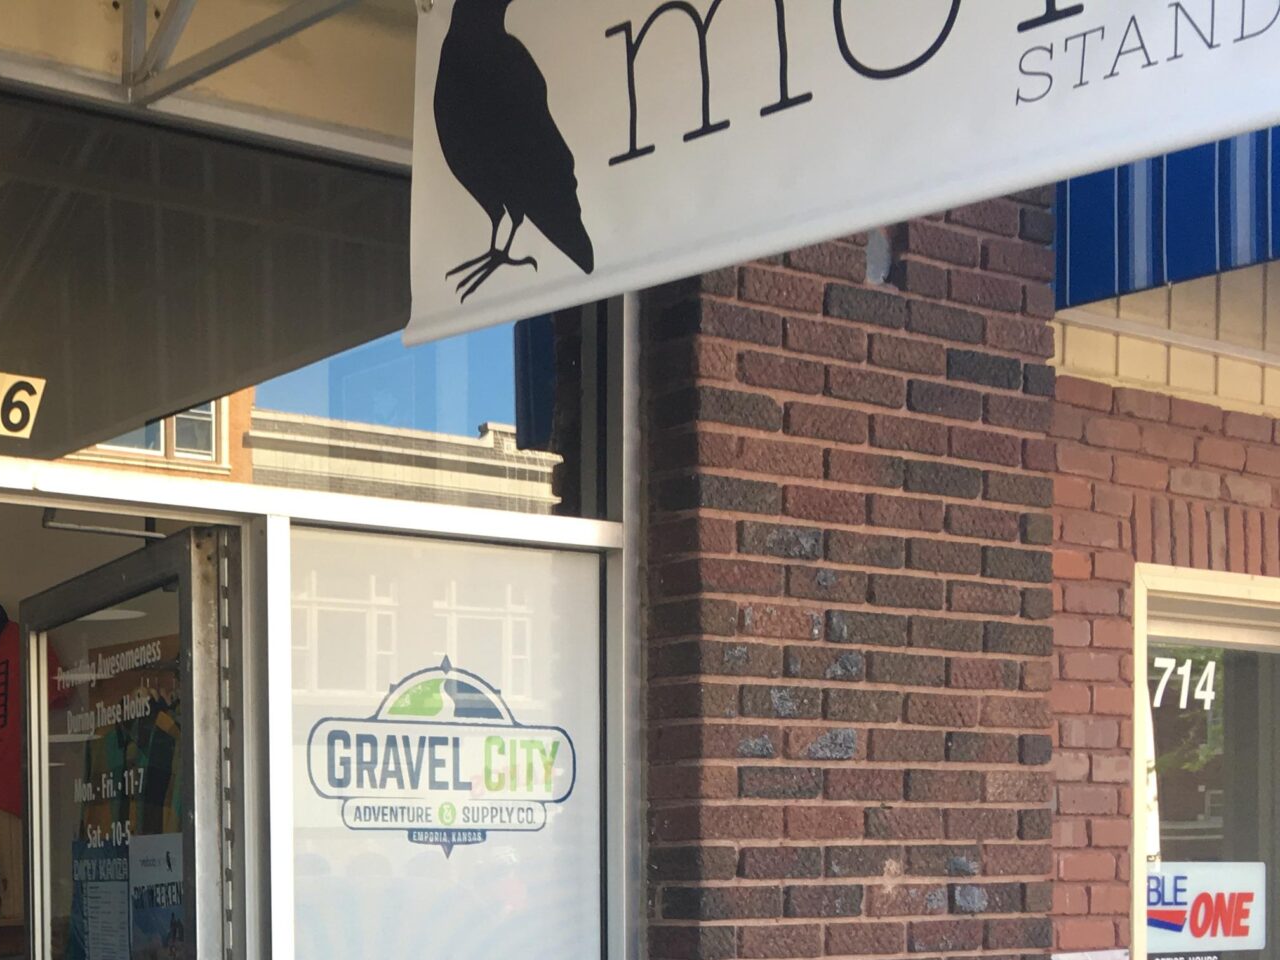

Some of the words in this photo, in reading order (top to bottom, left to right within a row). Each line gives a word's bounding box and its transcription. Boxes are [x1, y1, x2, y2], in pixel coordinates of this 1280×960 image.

[57, 661, 96, 691] Providing
[97, 640, 161, 680] Awesomeness
[1153, 657, 1216, 711] 714
[67, 708, 95, 735] During
[96, 702, 122, 728] These
[123, 694, 151, 721] Hours
[326, 730, 472, 791] GRAVEL
[483, 735, 561, 793] CITY
[74, 778, 96, 803] Mon.
[102, 772, 116, 799] Fri.
[123, 768, 145, 796] 11-7
[87, 824, 104, 849] Sat.
[111, 820, 131, 847] 10-5
[353, 805, 433, 824] ADVENTURE
[462, 806, 514, 823] SUPPLY
[517, 807, 536, 824] CO.
[412, 831, 451, 843] EMPORIA,
[452, 831, 482, 841] KANSAS
[1147, 876, 1188, 906] BLE
[1189, 892, 1254, 938] ONE
